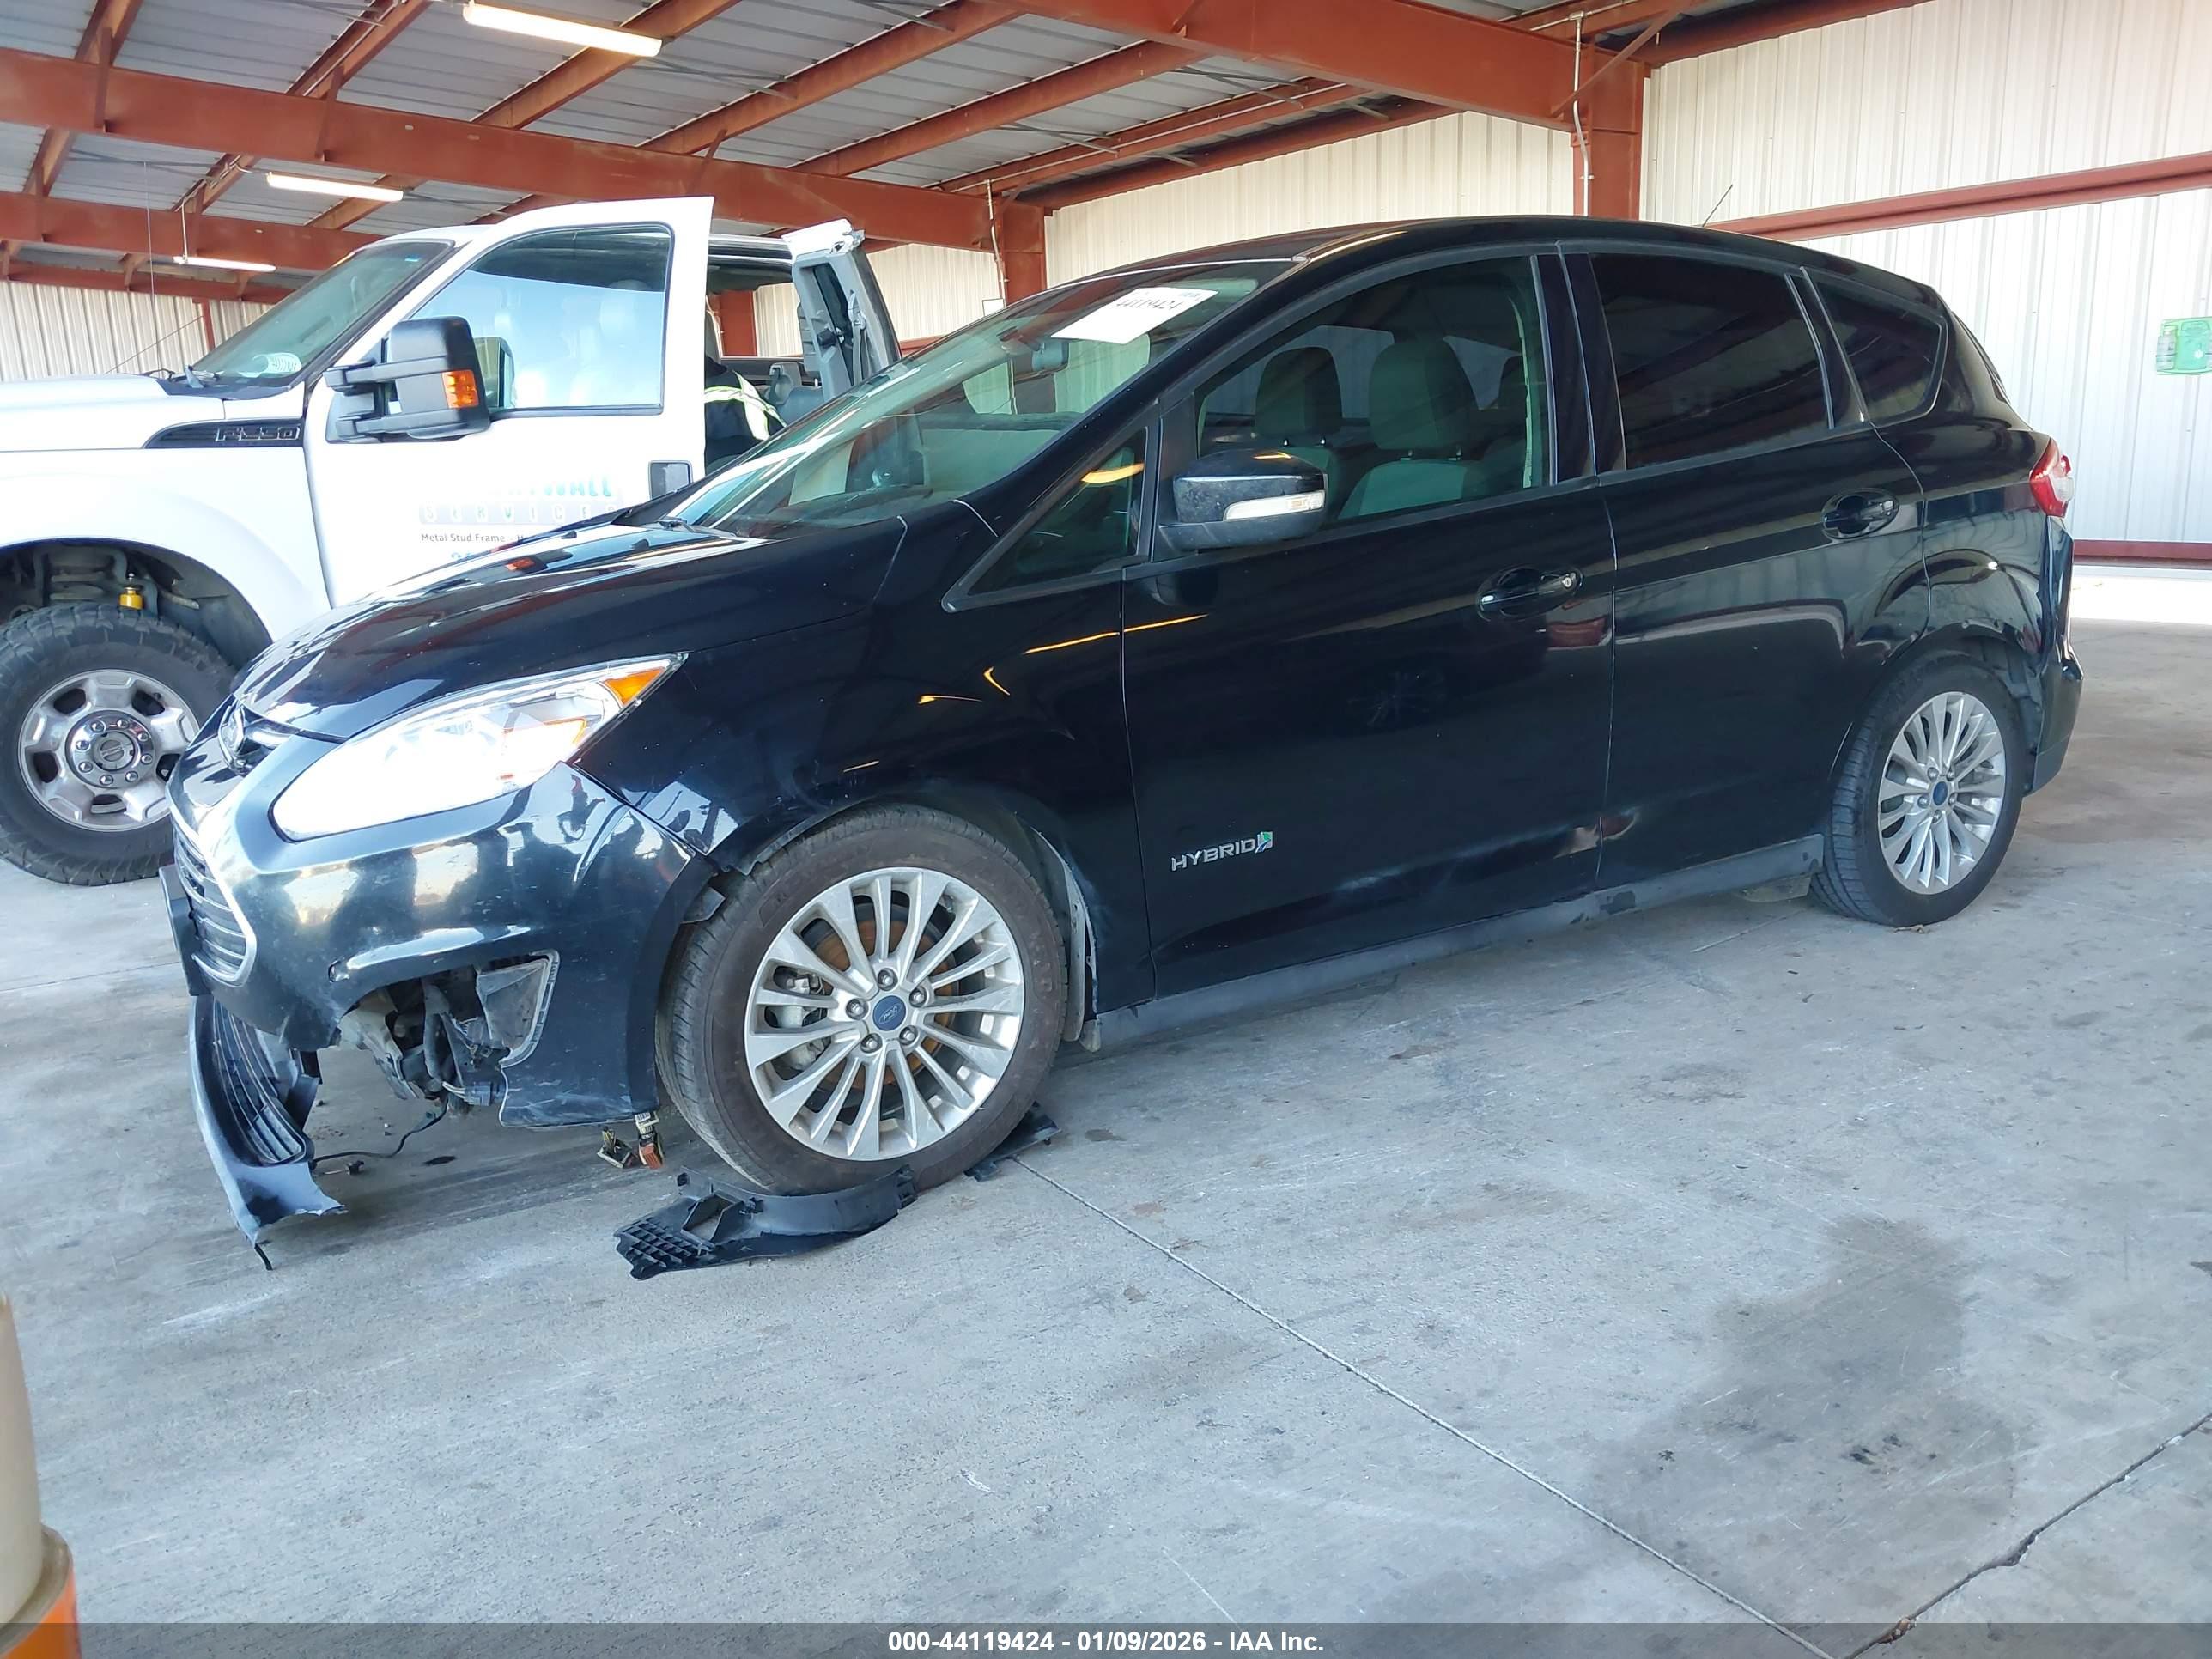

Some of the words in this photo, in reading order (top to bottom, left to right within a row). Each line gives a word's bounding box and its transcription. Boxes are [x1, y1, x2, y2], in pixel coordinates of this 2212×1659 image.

[421, 533, 447, 542] Metal
[450, 533, 472, 542] Stud
[475, 533, 505, 542] Frame
[1170, 838, 1256, 872] HYBRID
